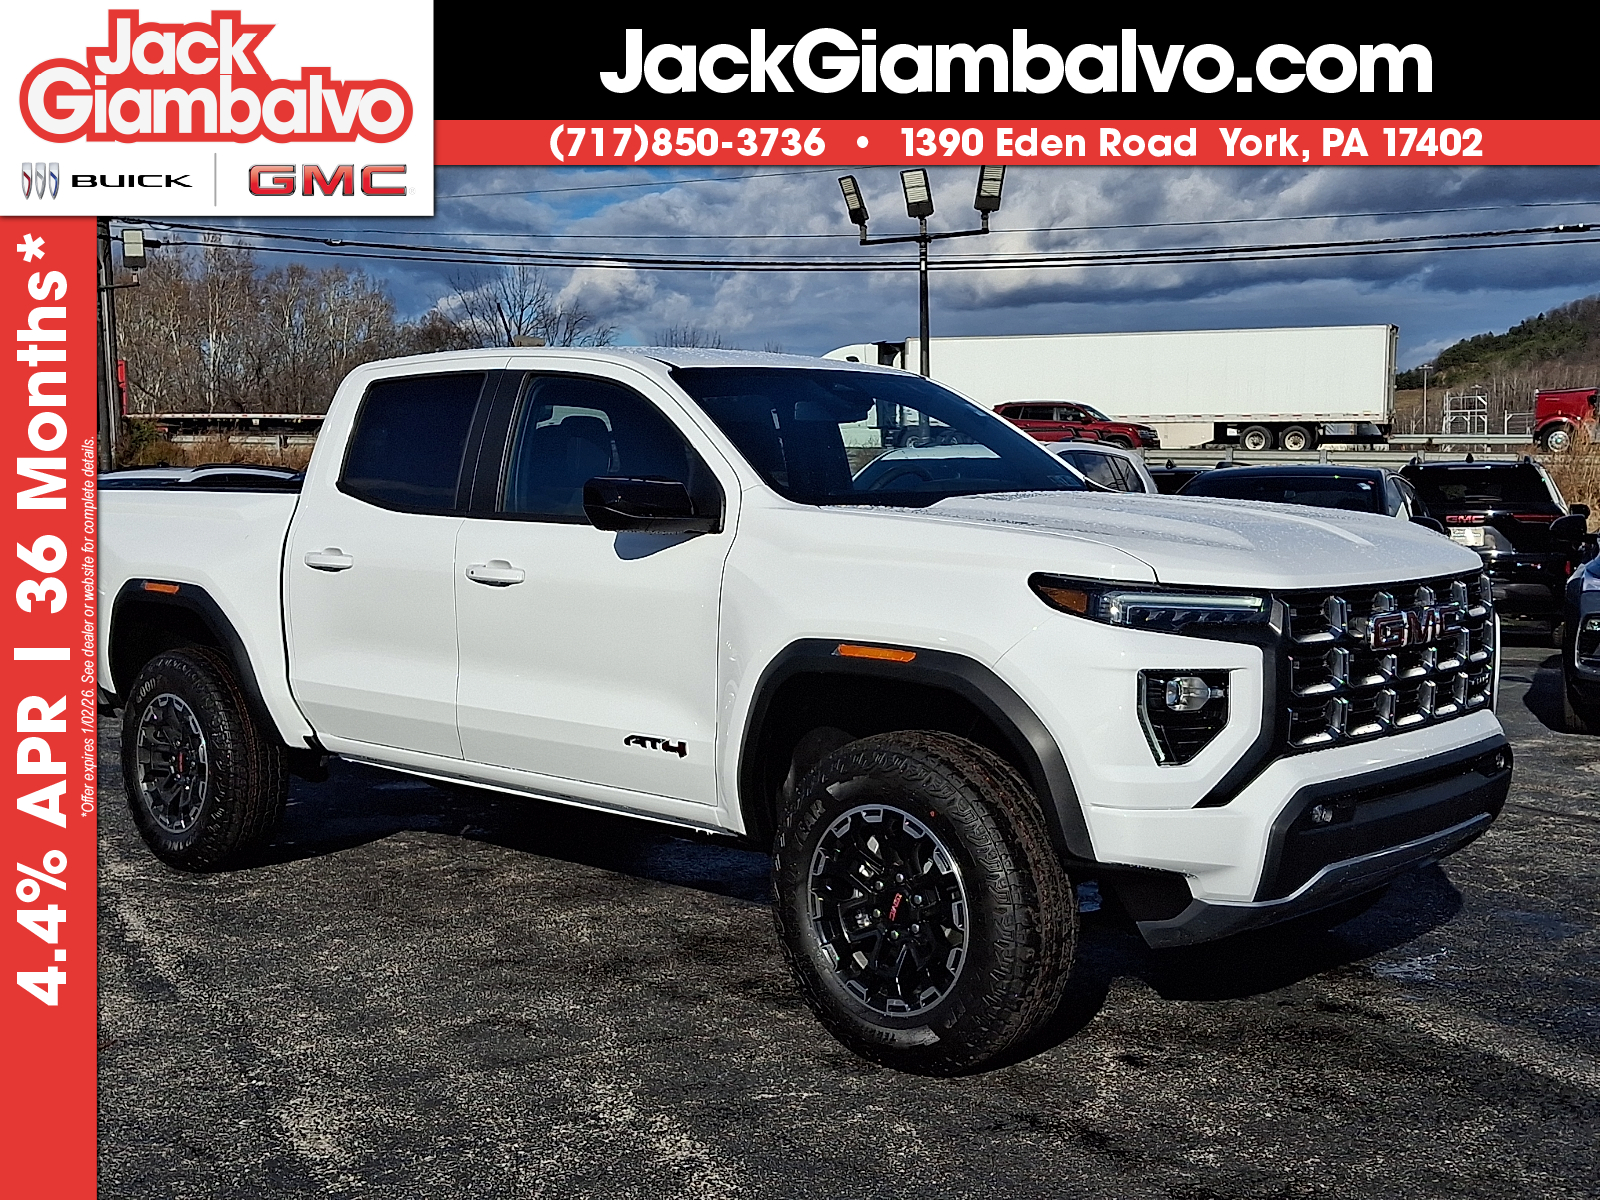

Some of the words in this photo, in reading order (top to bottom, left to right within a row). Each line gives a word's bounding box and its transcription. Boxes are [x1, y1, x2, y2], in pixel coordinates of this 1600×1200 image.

[1445, 515, 1485, 524] GMC
[1369, 604, 1461, 651] GMC
[623, 734, 687, 759] AT4
